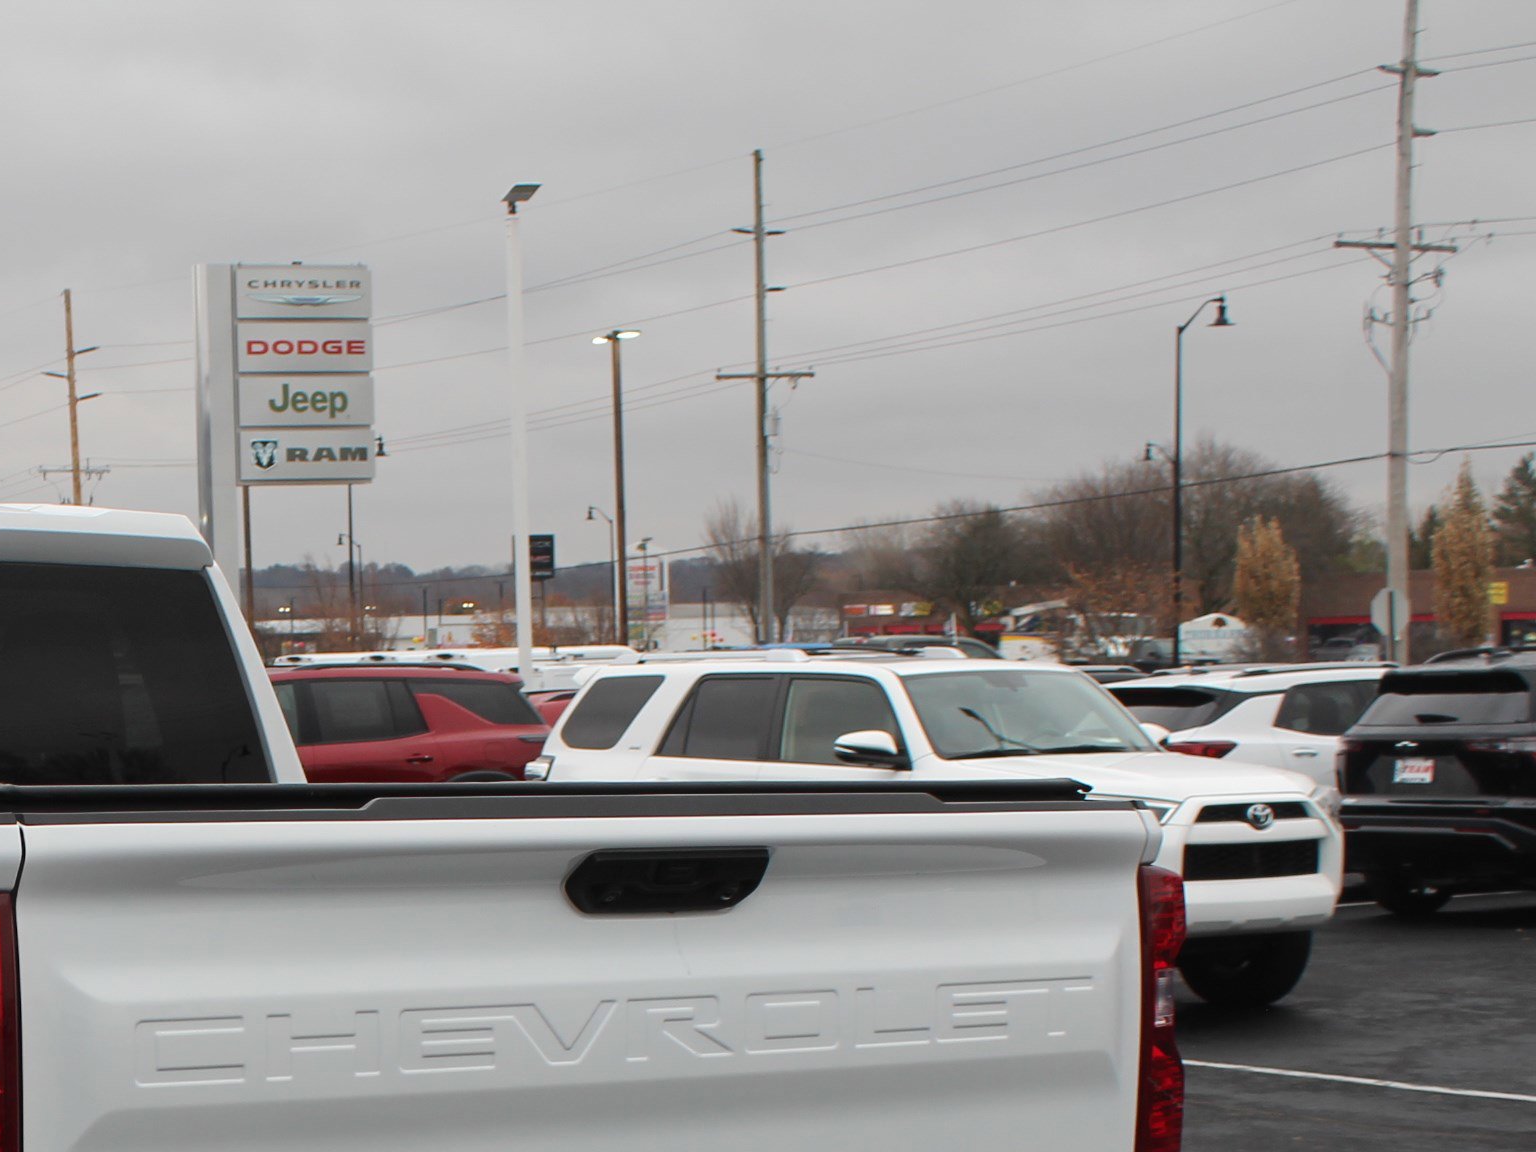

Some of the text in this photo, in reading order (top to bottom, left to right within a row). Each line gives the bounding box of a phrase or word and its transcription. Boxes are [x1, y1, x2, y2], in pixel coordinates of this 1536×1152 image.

[247, 279, 363, 289] CHRYSLER
[246, 340, 367, 355] DODGE
[268, 383, 349, 419] Jeep
[285, 446, 369, 463] RAM
[133, 975, 1096, 1088] CHEVROLET
